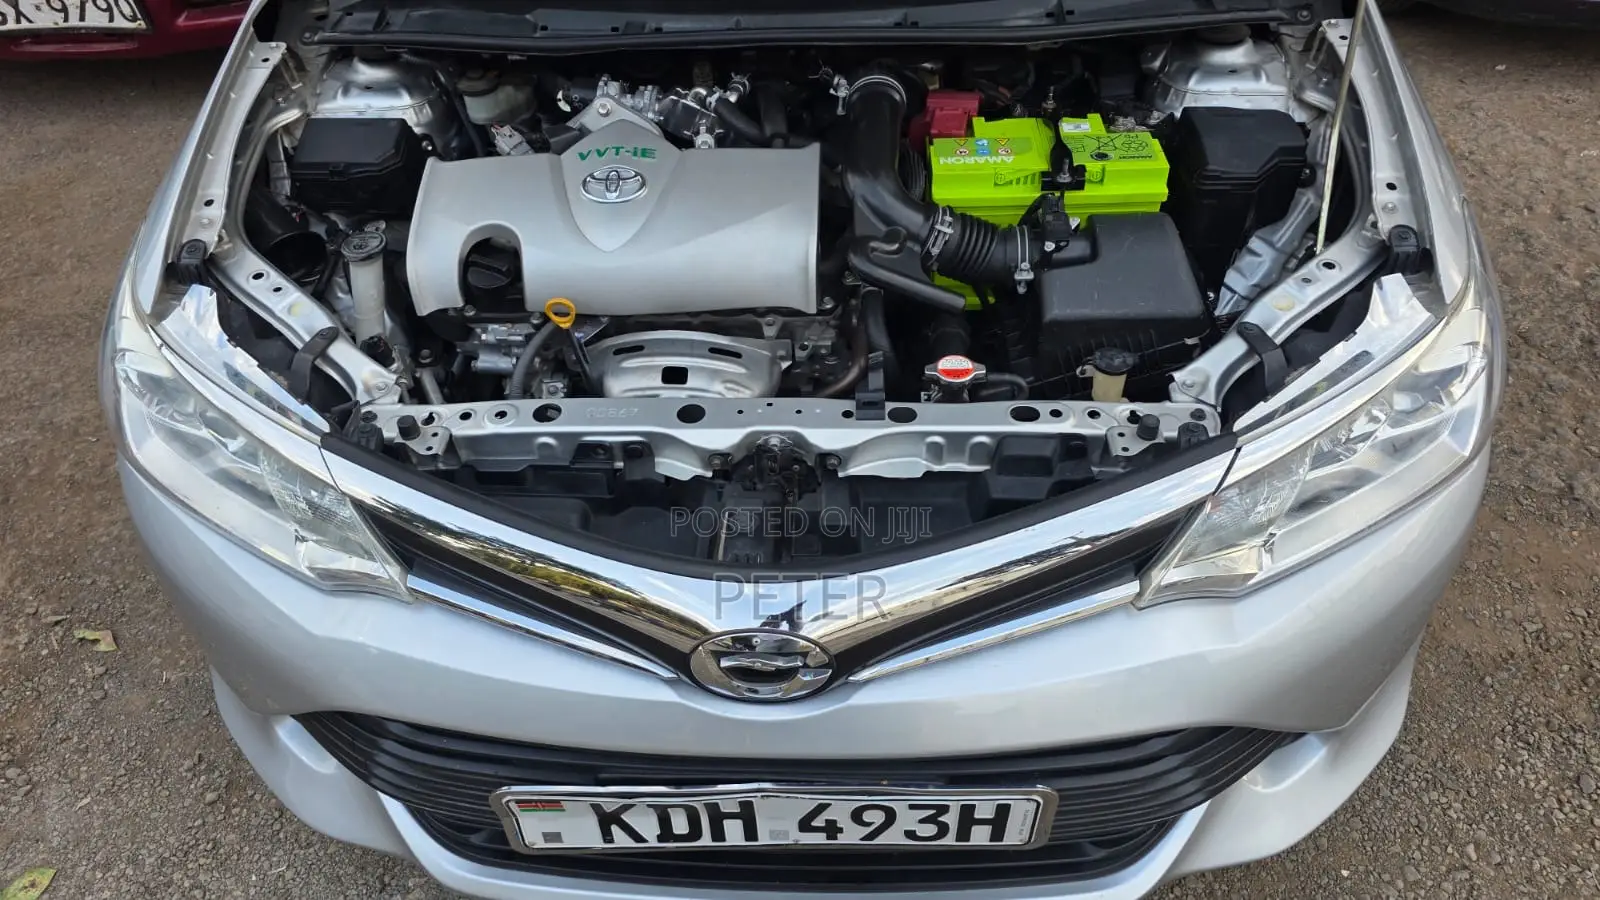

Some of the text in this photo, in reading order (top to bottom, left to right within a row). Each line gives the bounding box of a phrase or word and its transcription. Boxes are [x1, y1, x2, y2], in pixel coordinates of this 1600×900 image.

[940, 156, 1015, 165] AMARON
[590, 800, 759, 843] KDH
[797, 802, 1011, 842] 493H
